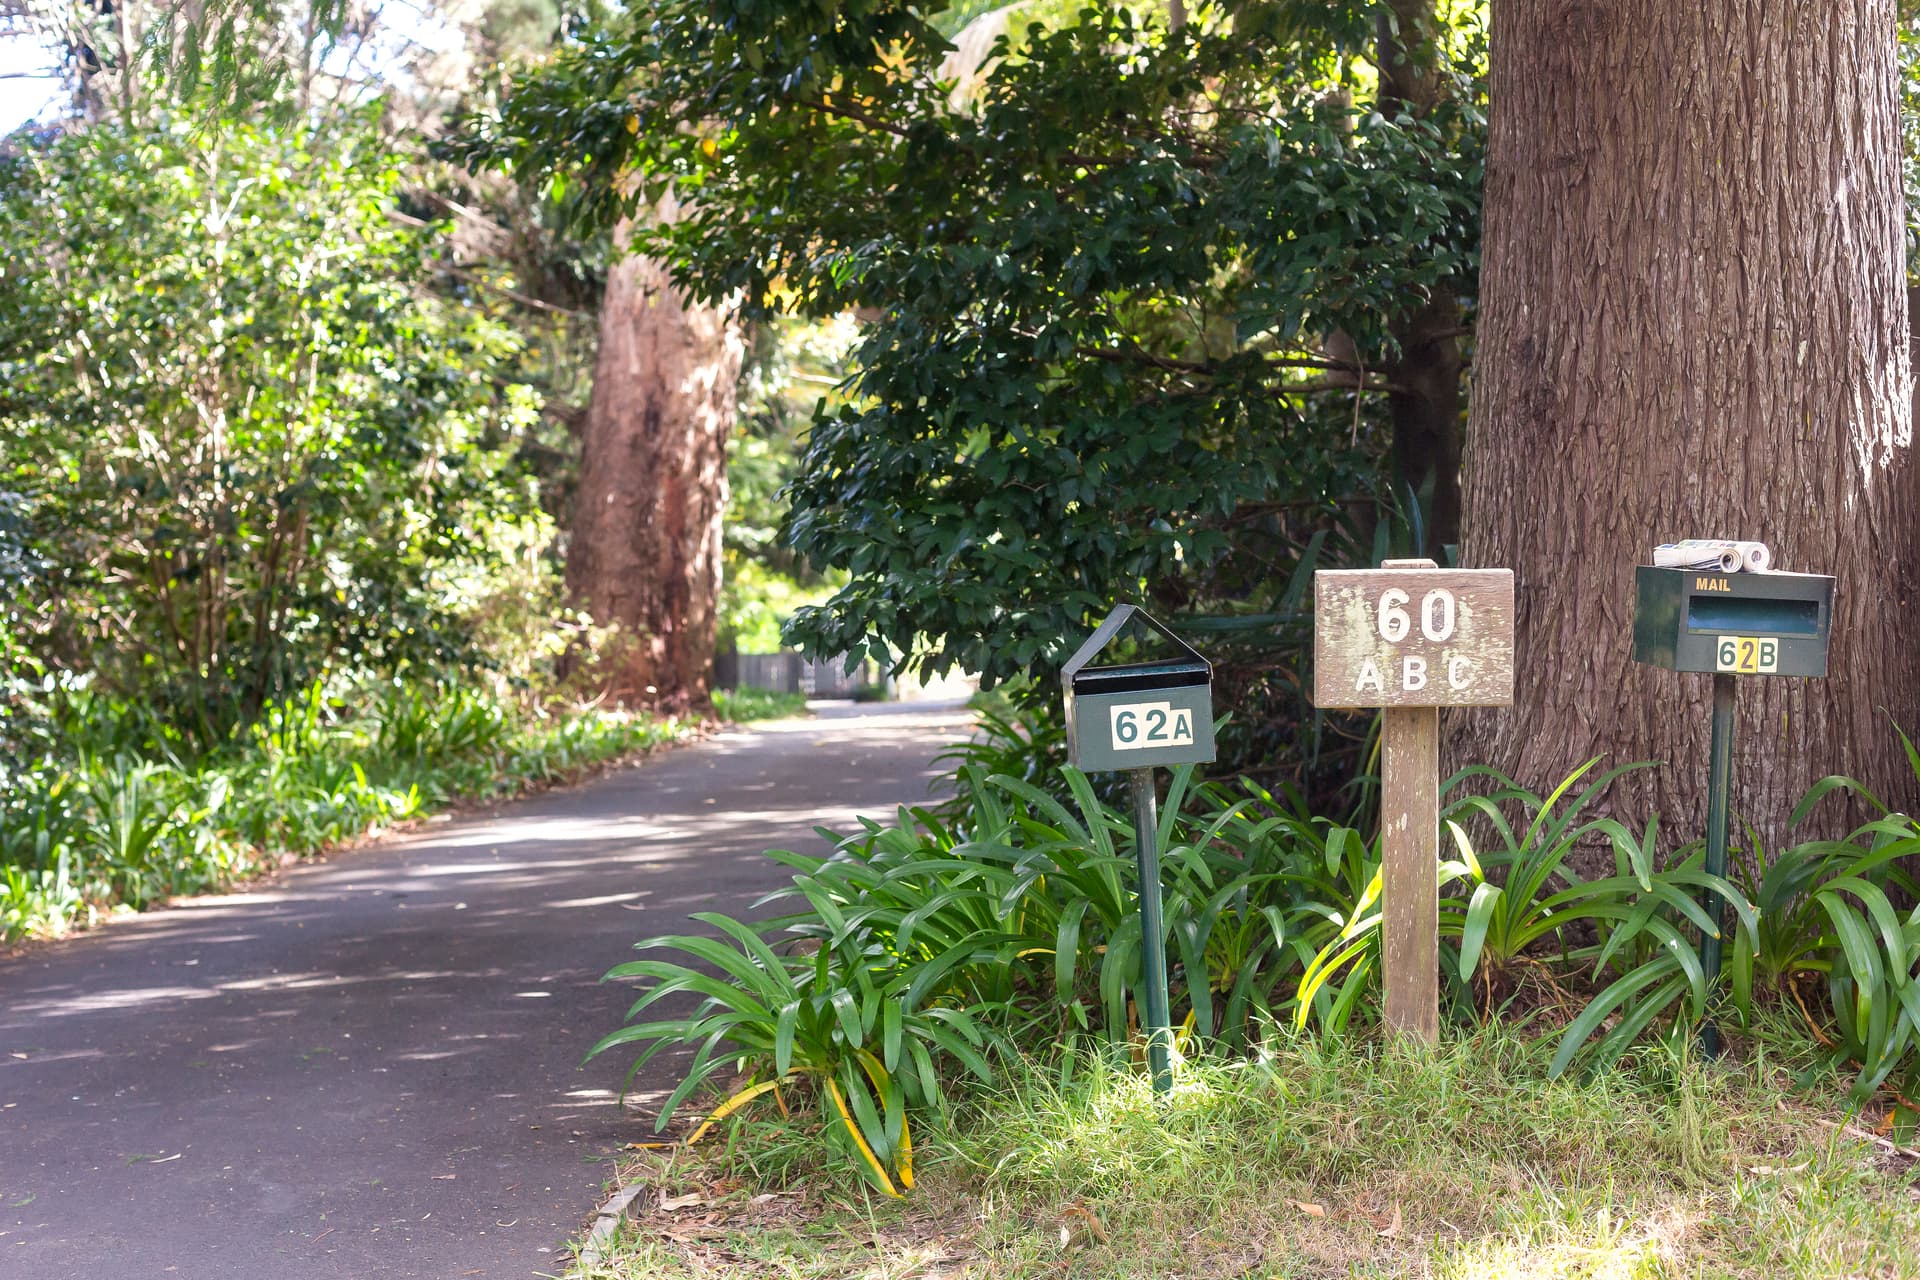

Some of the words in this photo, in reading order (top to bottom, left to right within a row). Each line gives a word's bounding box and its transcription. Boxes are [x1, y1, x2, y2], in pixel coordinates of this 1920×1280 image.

[1695, 577, 1731, 592] MAIL
[1378, 587, 1455, 643] 60
[1719, 640, 1776, 670] 62B
[1355, 656, 1384, 692] A
[1402, 655, 1428, 691] B
[1448, 655, 1473, 690] C
[1115, 709, 1192, 743] 62A
